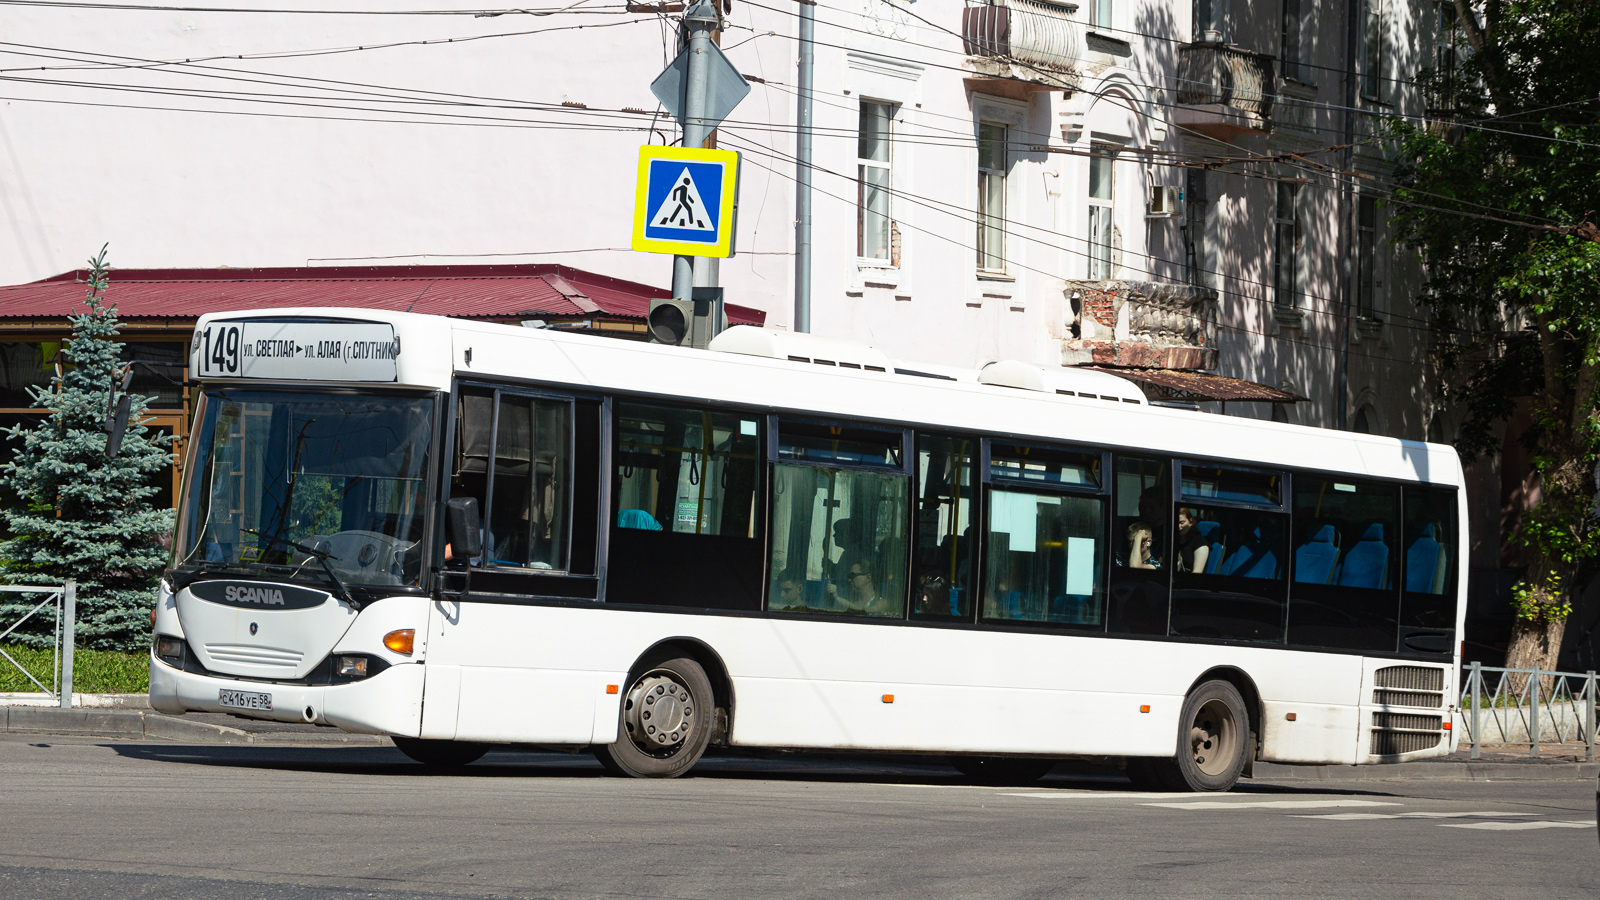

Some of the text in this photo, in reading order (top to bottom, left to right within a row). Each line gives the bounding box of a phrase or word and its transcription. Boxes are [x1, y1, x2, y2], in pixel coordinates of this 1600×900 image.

[203, 326, 240, 373] 149
[243, 343, 254, 357] ул.
[256, 339, 295, 358] СВЕТЛАЯ
[304, 344, 316, 358] ул.
[317, 340, 341, 359] АЛАЯ
[225, 585, 285, 605] SCANIA
[259, 694, 269, 705] 58
